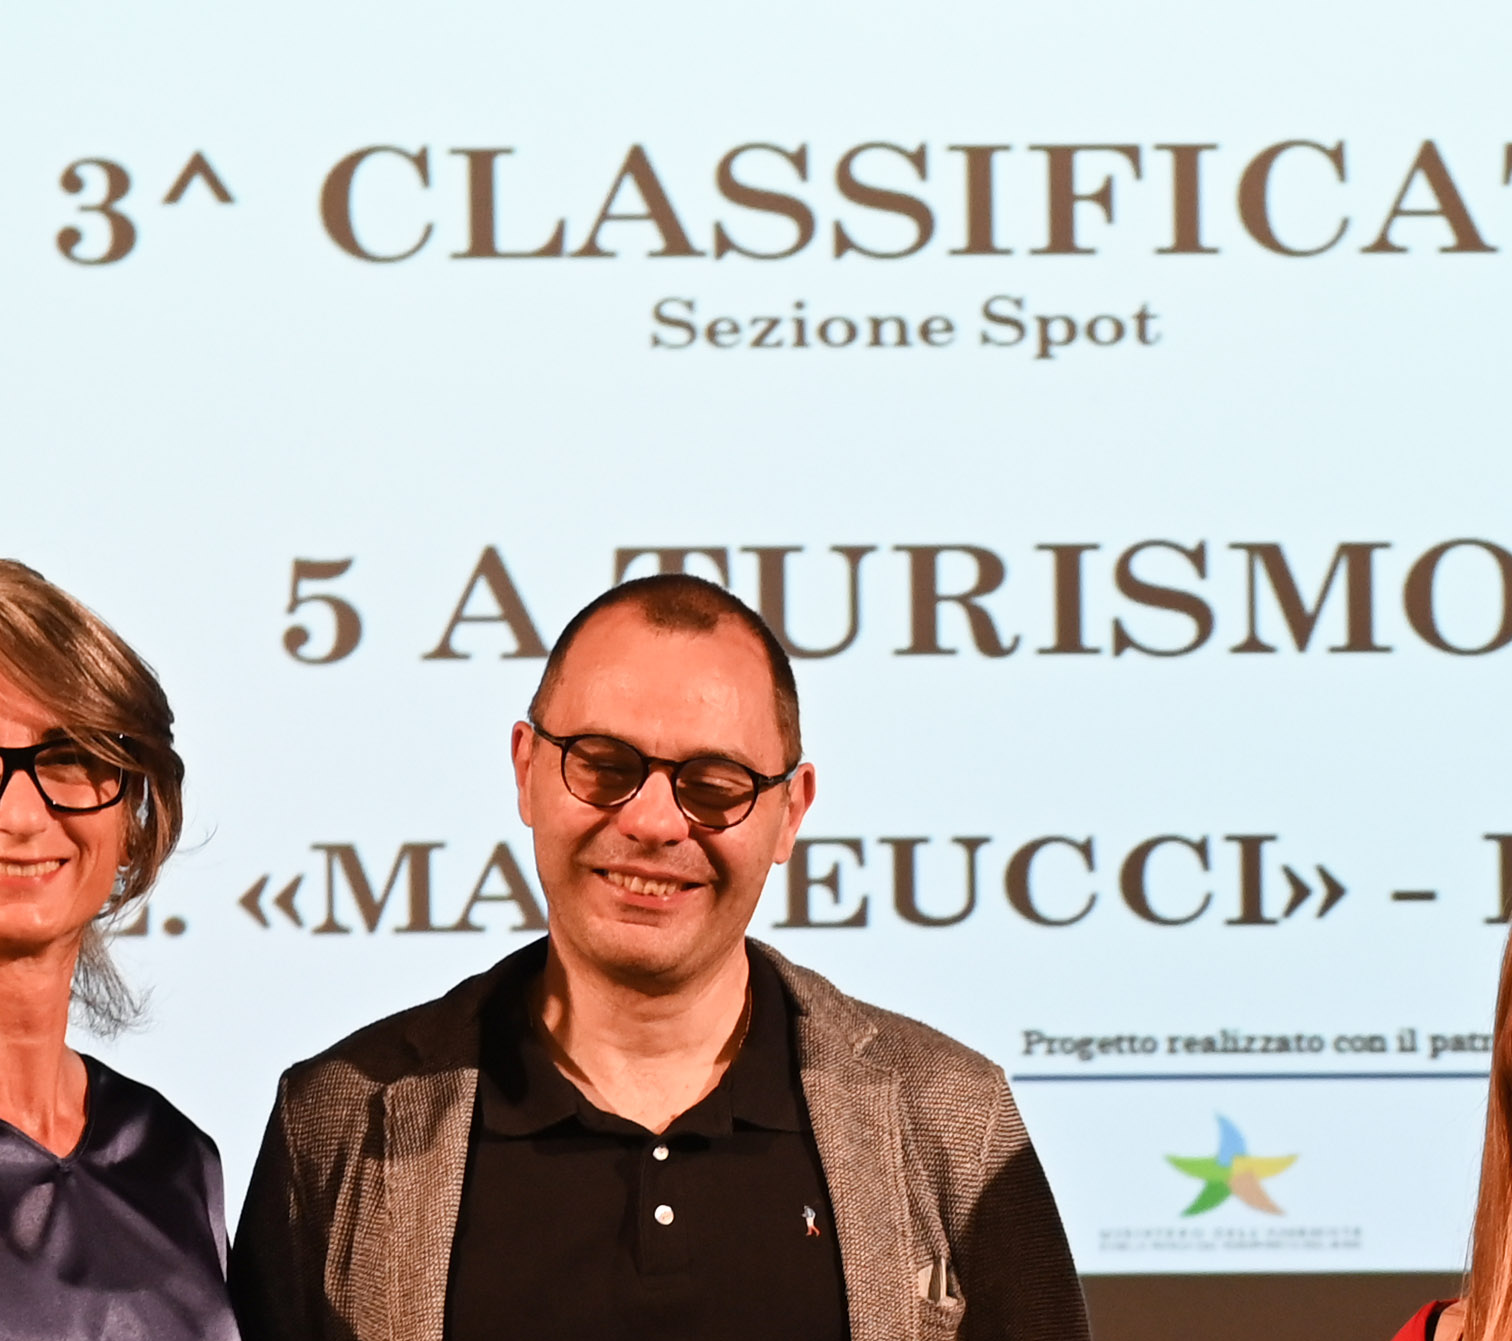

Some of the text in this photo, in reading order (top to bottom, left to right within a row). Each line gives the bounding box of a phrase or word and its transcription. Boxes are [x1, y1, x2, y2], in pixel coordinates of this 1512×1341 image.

[650, 294, 1162, 361] Sezione Spot
[283, 556, 363, 666] 5
[421, 545, 550, 661] A
[238, 835, 1348, 935] «MAEUCCI»
[1022, 1029, 1158, 1061] Progetto
[1166, 1028, 1326, 1057] realizzato
[1333, 1033, 1390, 1054] con
[1397, 1027, 1418, 1053] il
